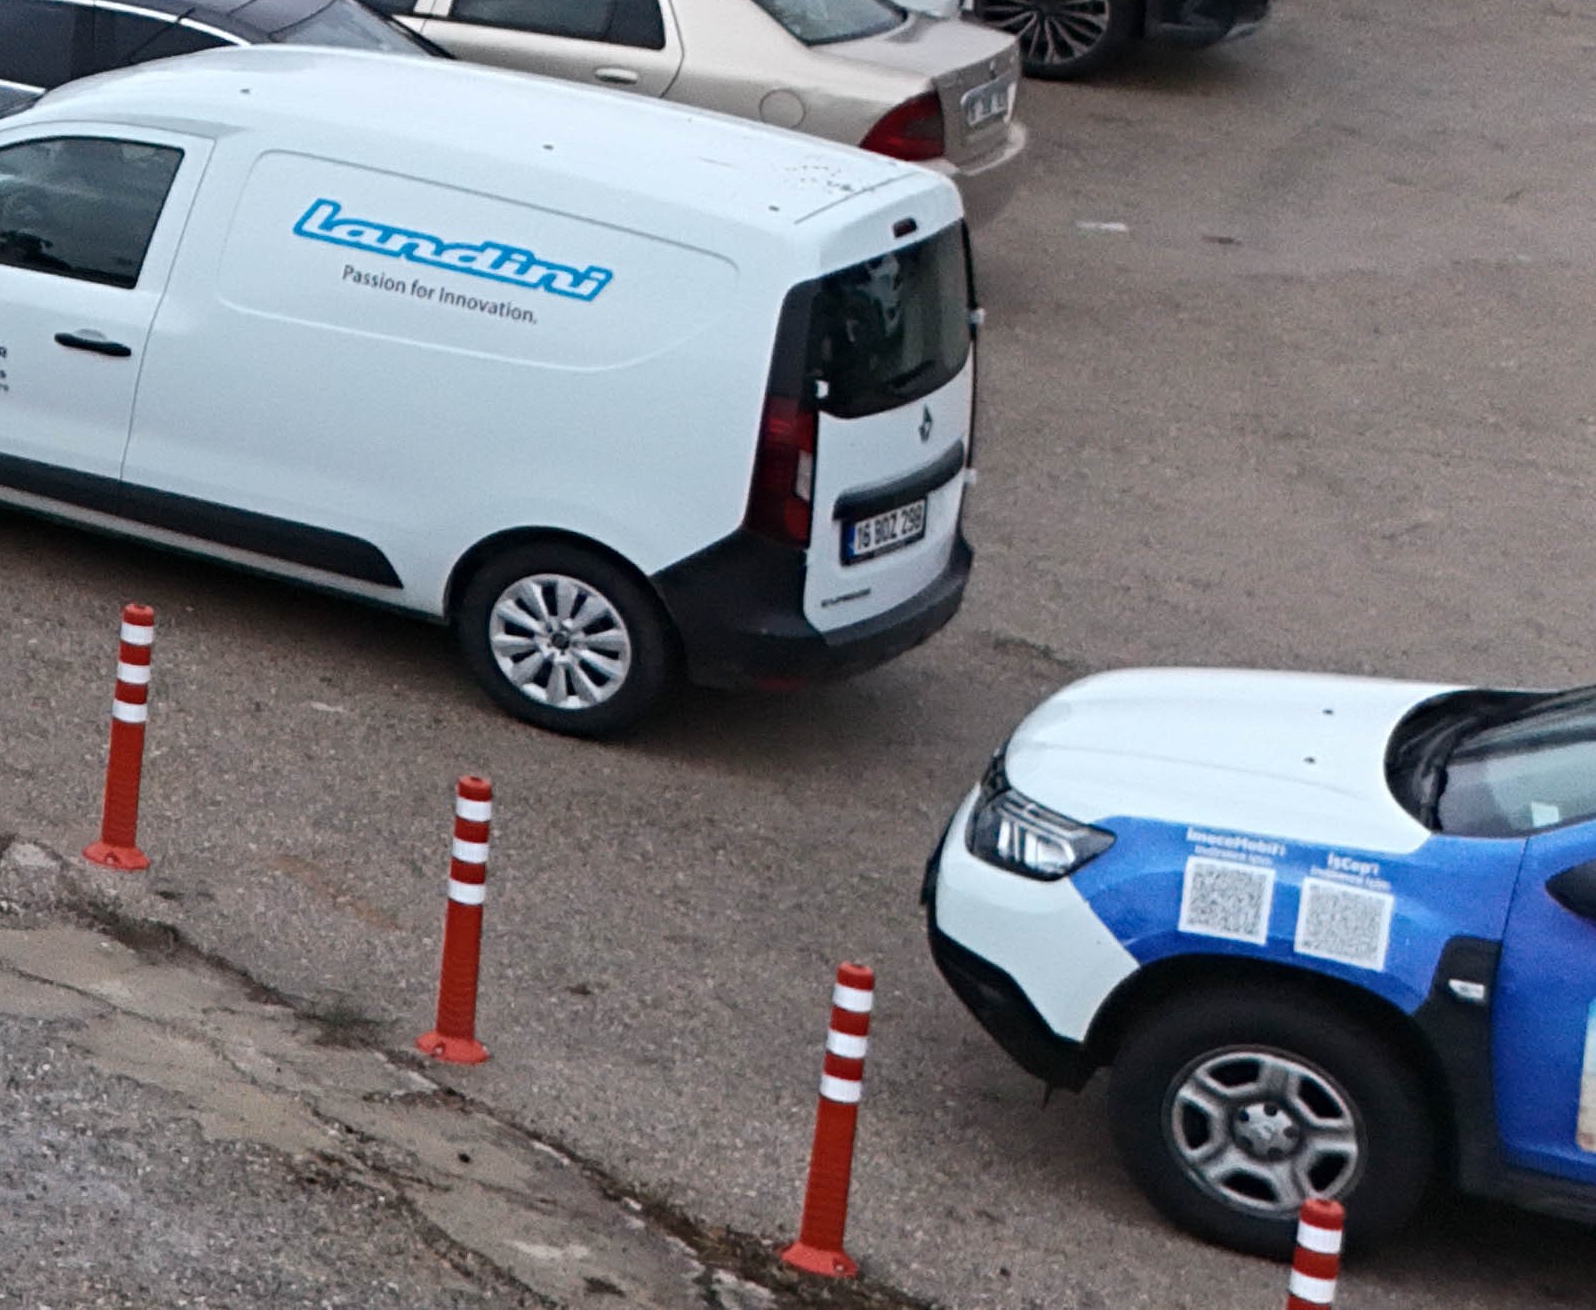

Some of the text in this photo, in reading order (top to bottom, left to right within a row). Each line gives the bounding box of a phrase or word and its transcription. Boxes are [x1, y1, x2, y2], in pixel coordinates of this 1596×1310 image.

[293, 198, 613, 302] Landini
[342, 265, 537, 324] Passion for Innovation.
